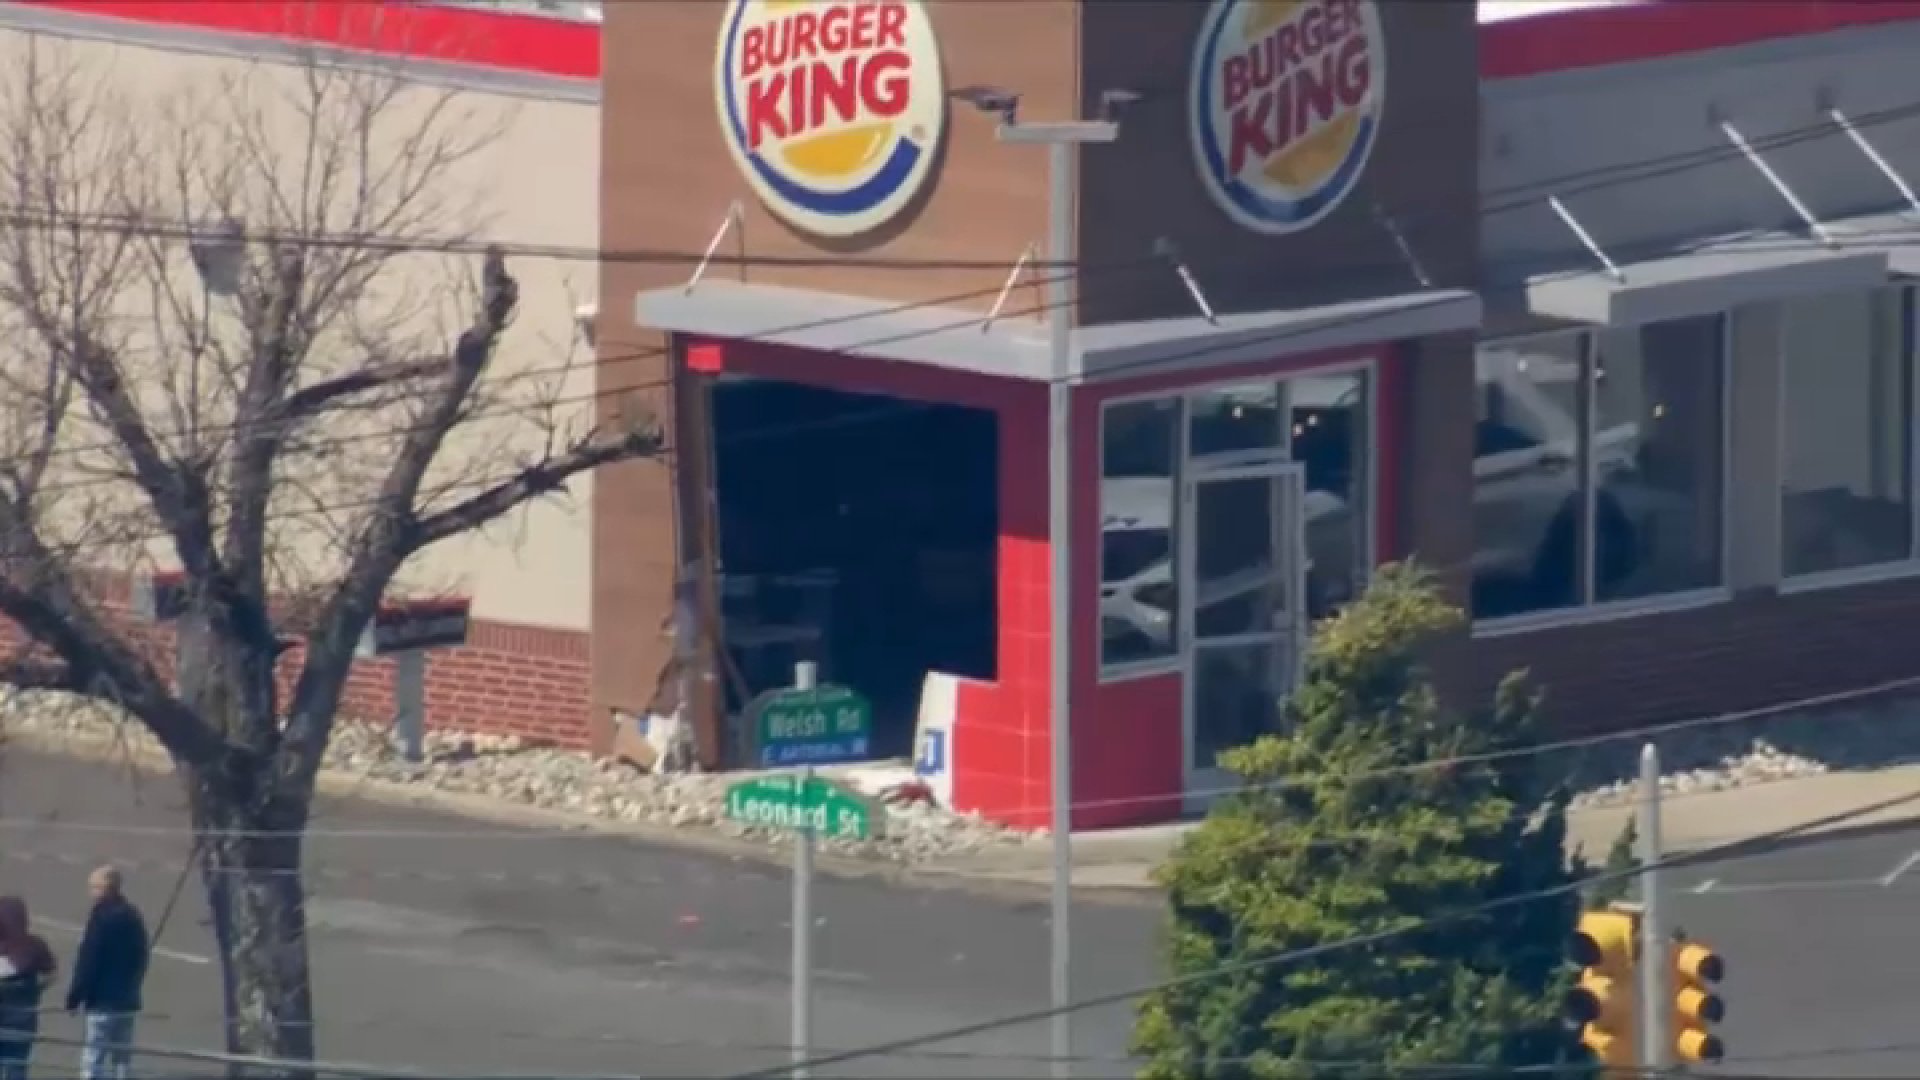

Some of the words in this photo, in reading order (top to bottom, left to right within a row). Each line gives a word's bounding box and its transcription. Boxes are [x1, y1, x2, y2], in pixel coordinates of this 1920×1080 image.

[741, 3, 908, 78] BURGER
[1222, 0, 1364, 112] BURGER
[747, 50, 911, 151] KING
[1228, 32, 1369, 175] KING
[769, 709, 827, 739] Welsh
[836, 706, 860, 732] Rd
[732, 788, 828, 831] Leonard
[838, 808, 861, 838] St
